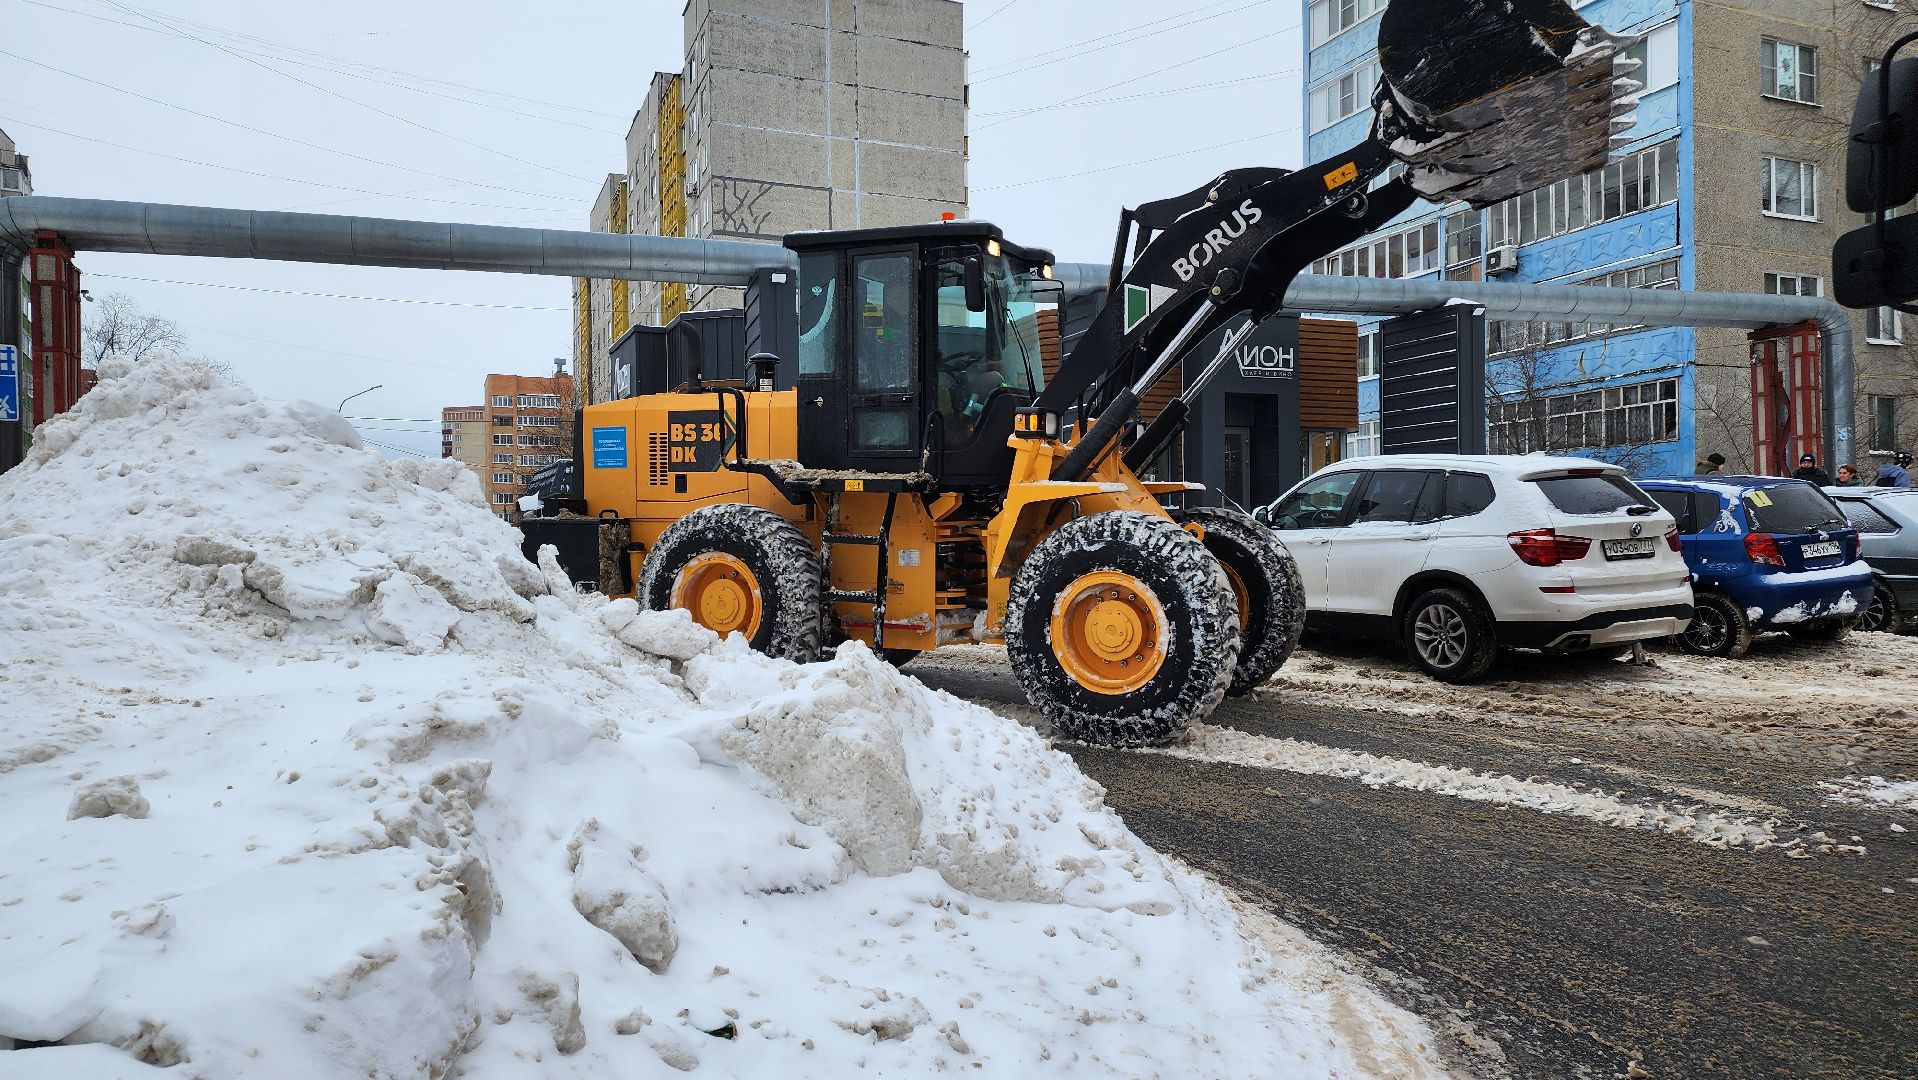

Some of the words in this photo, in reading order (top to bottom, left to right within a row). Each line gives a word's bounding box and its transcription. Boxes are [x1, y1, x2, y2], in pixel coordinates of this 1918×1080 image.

[1172, 199, 1262, 282] BORUS
[670, 423, 697, 442] BS
[670, 446, 697, 463] DK
